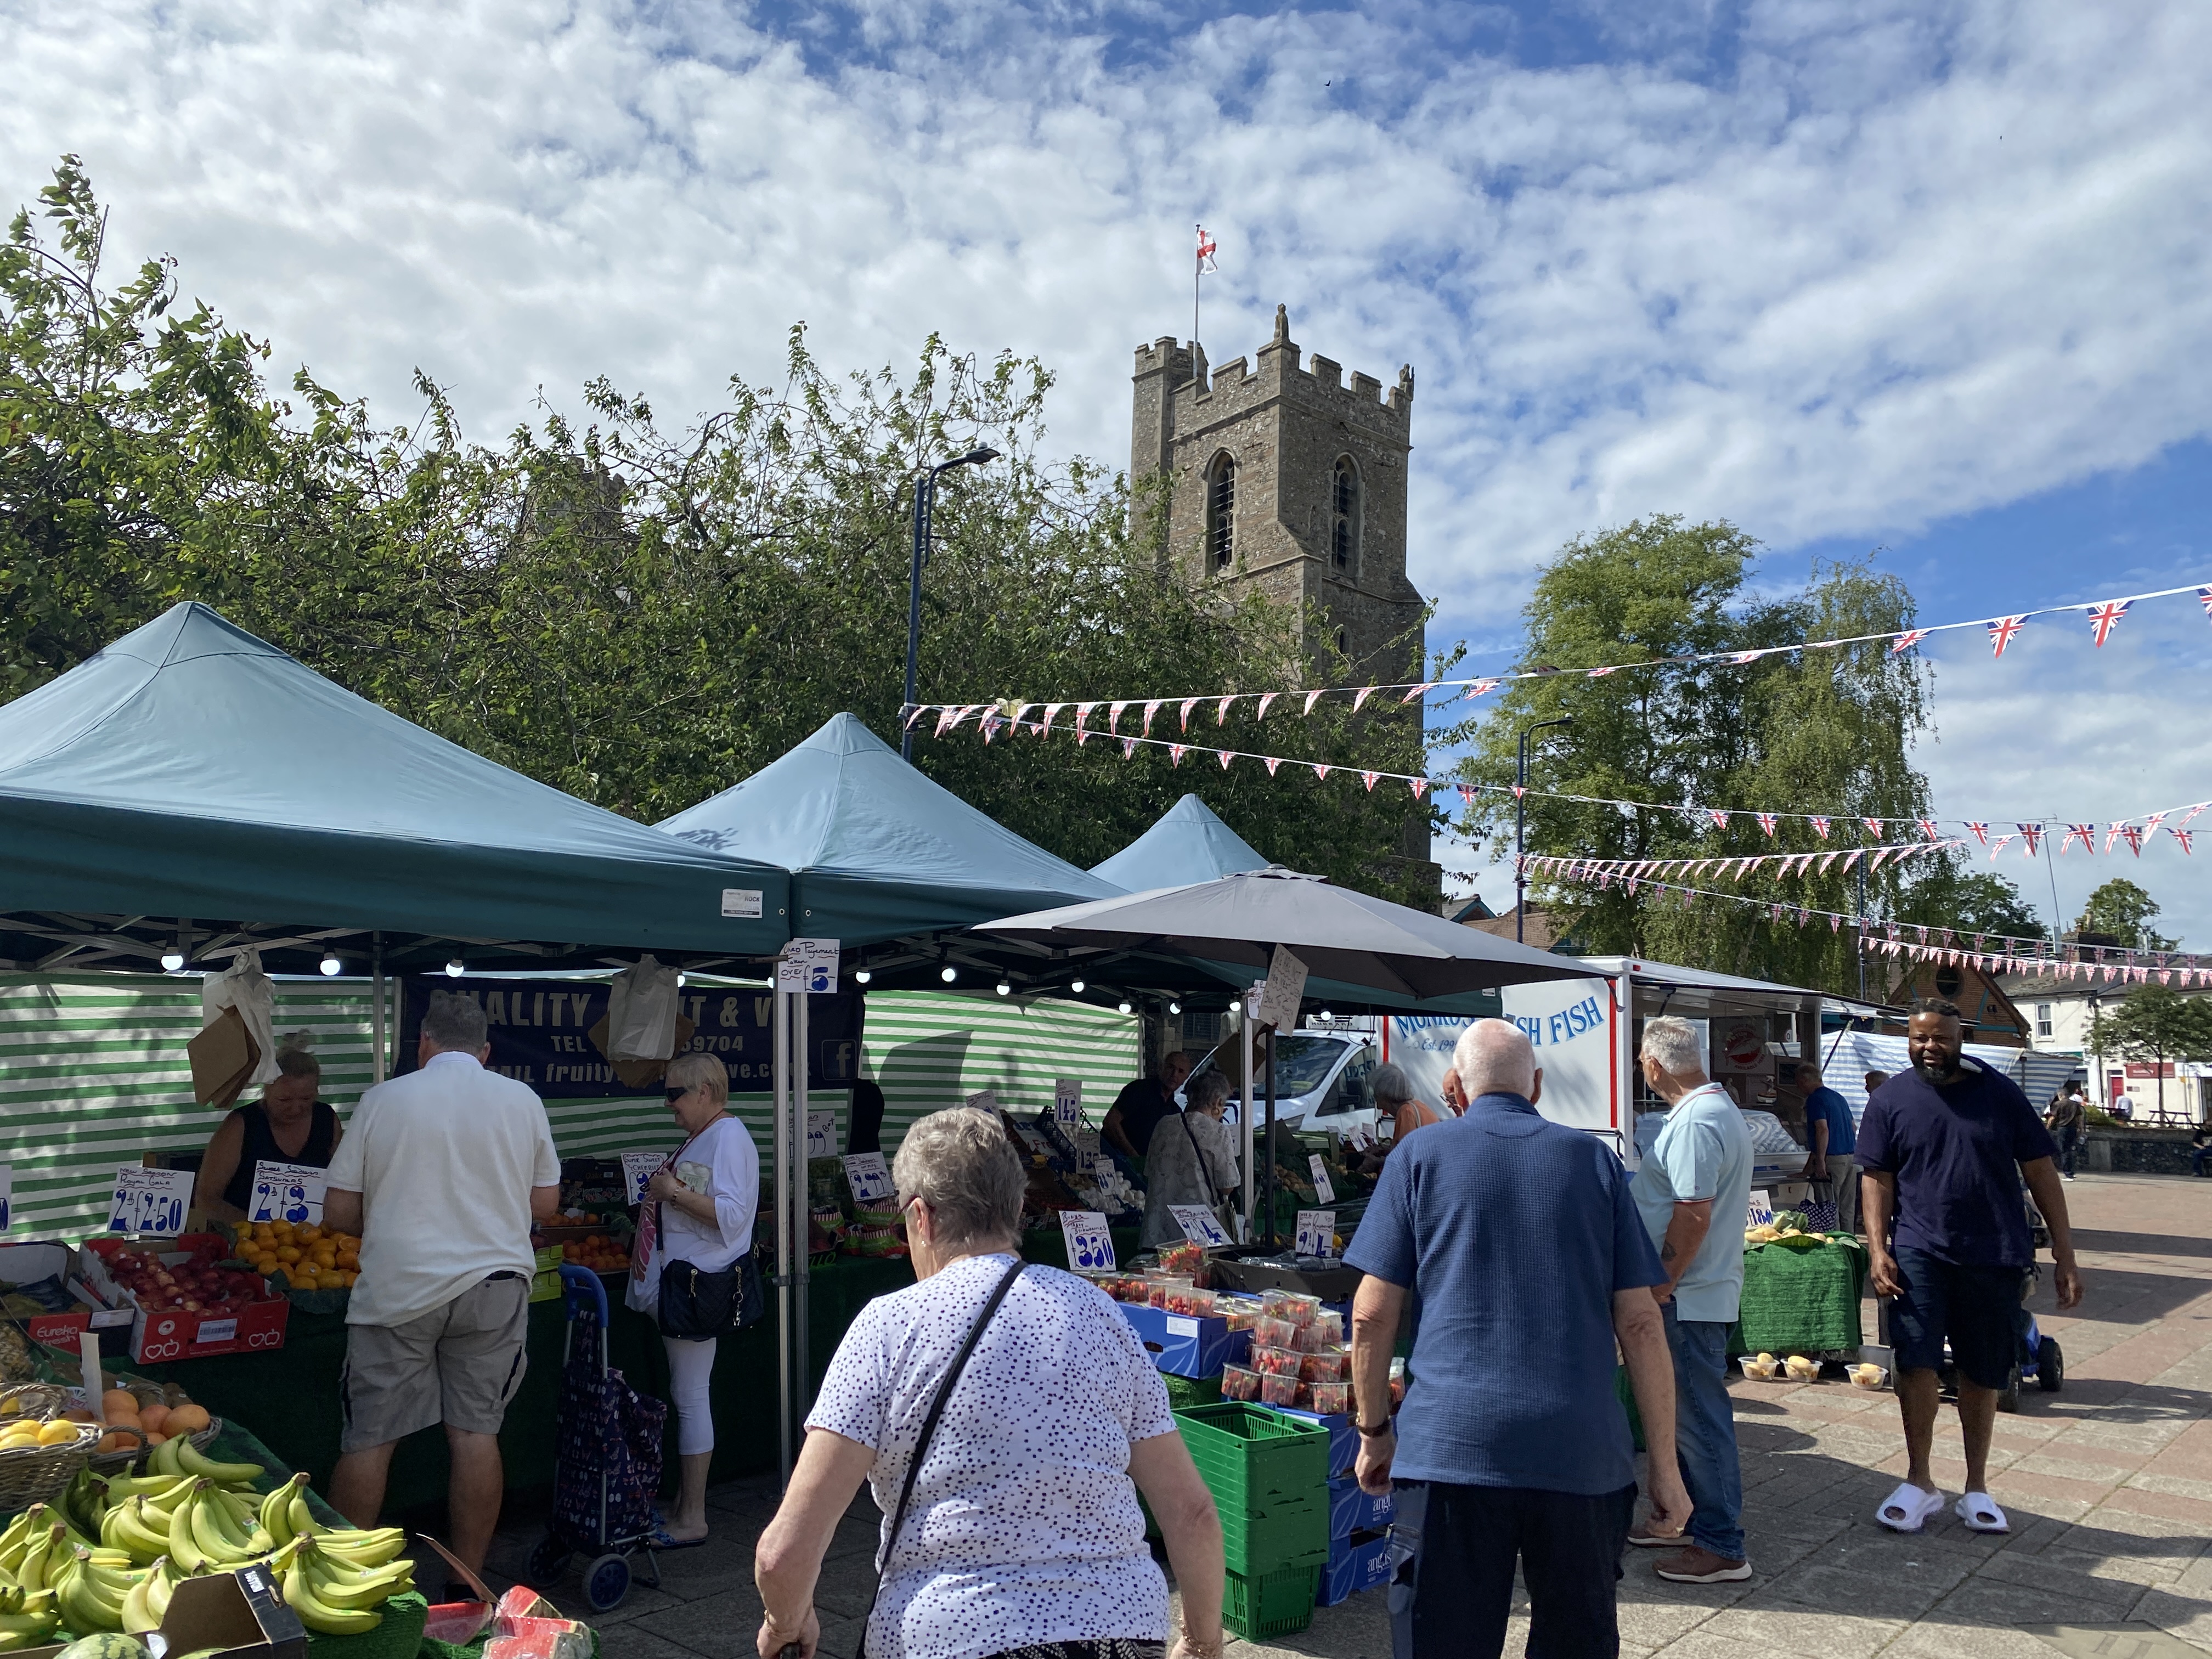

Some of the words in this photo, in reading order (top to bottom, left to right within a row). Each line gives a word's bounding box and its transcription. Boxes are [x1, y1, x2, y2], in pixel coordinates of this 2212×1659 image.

[430, 989, 591, 1026] ALITY
[1548, 996, 1605, 1046] FISH
[550, 1036, 586, 1052] TEL
[1439, 1039, 1457, 1052] 199
[37, 1325, 78, 1338] Eureka
